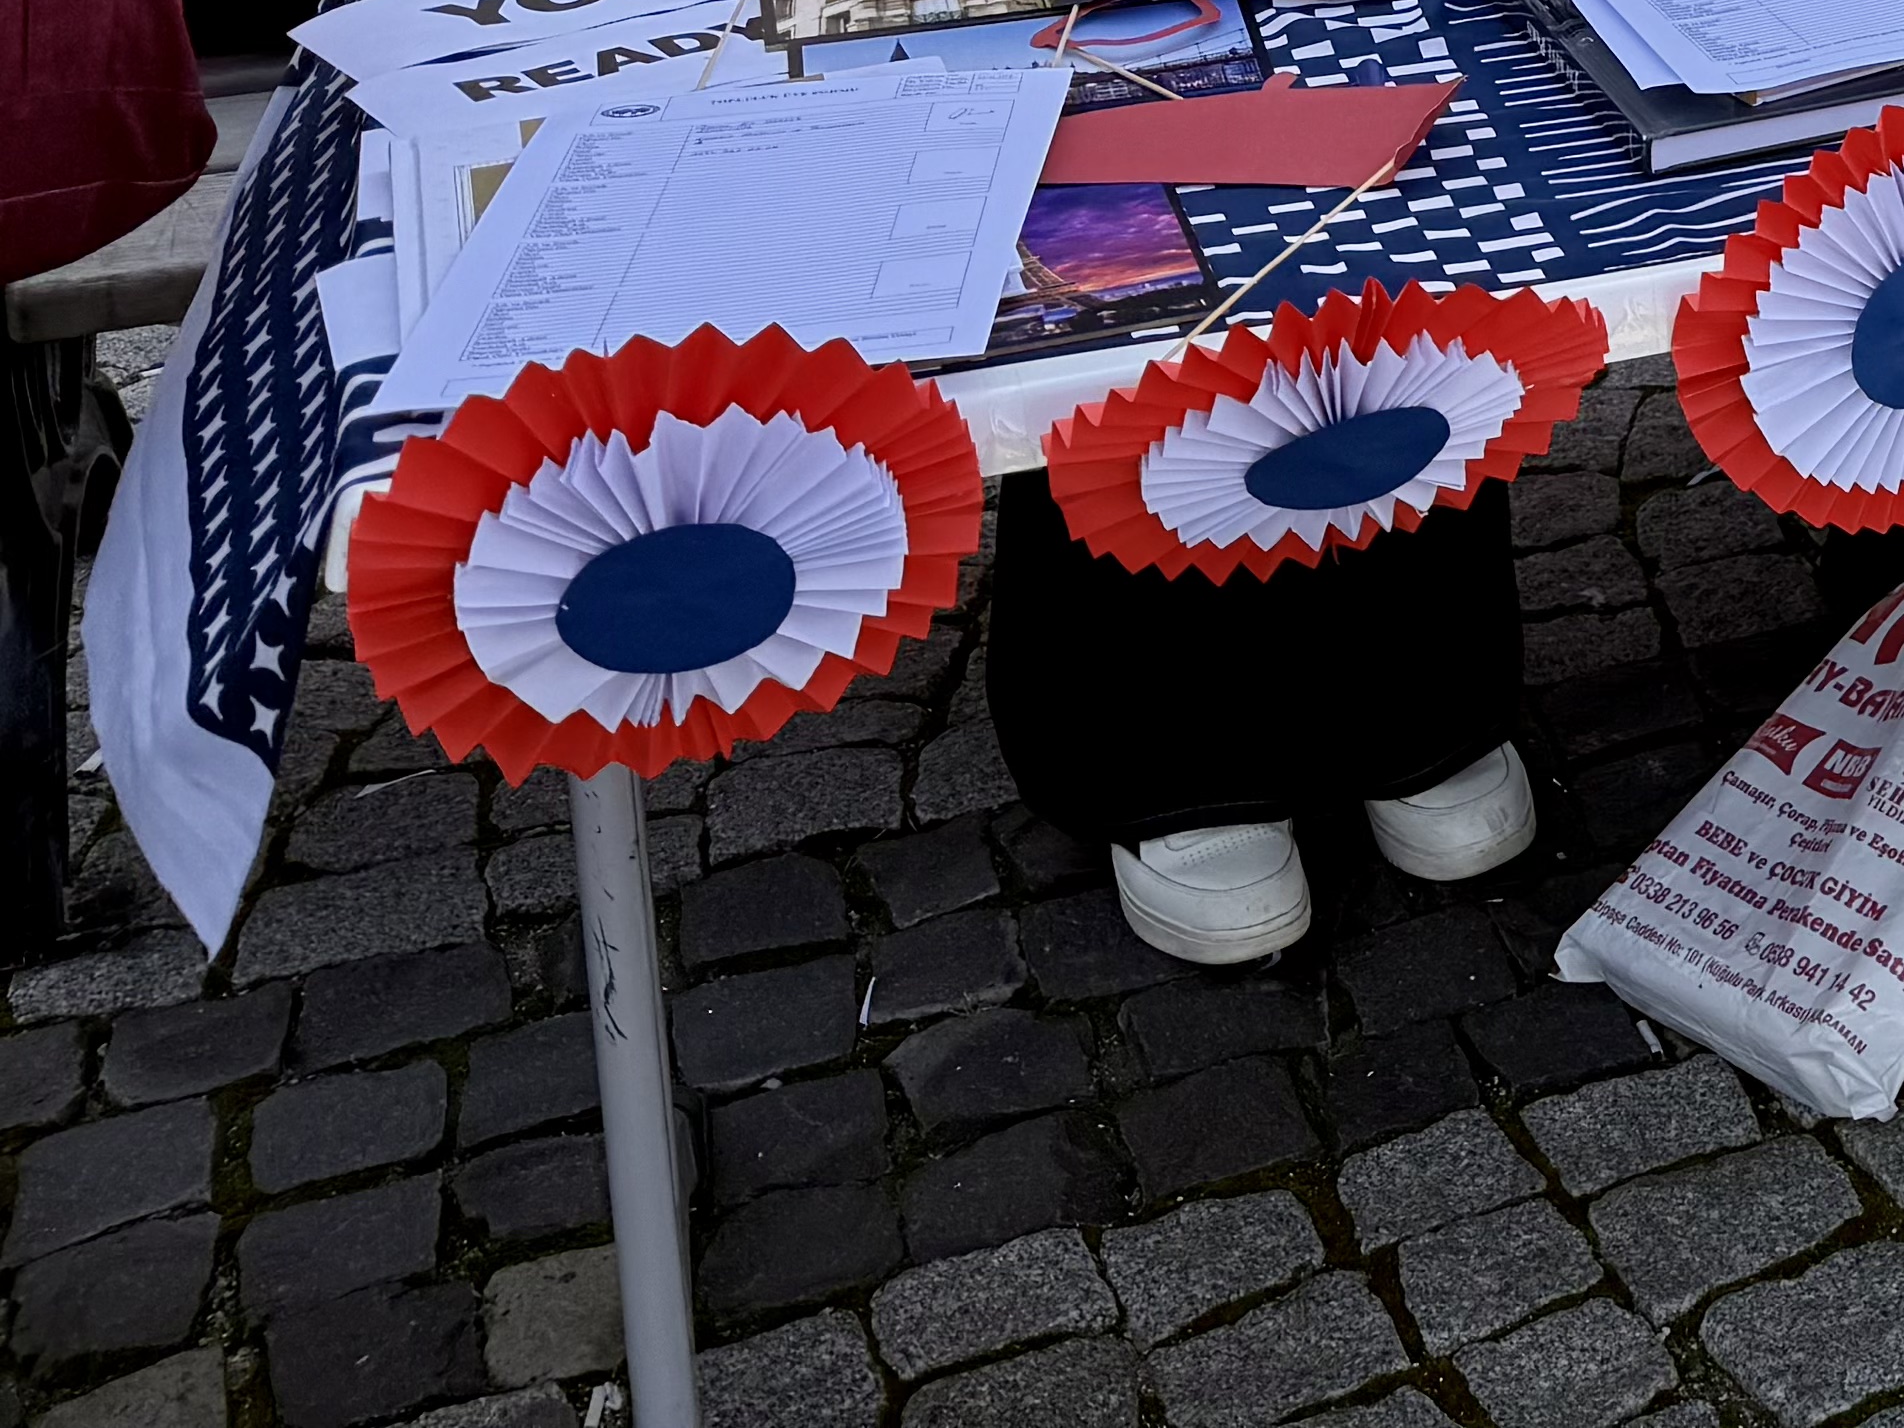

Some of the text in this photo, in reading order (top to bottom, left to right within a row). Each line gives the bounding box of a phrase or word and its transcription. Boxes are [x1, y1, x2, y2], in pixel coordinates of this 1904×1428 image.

[1722, 770, 1776, 810] Çamaşır,
[1778, 801, 1818, 832] Çorap,
[1850, 825, 1867, 841] ve
[1643, 839, 1690, 867] ptan
[1689, 855, 1769, 911] Fiyatına
[1767, 898, 1863, 954] Perakende
[1695, 820, 1748, 857] BEBE
[1747, 846, 1768, 870] ve
[1819, 878, 1889, 922] GİYİM
[1625, 915, 1668, 947] Caddesi
[1683, 947, 1704, 967] 101
[1630, 873, 1740, 940] 0338 213 96 56
[1793, 956, 1830, 987] 941
[1828, 971, 1852, 993] 14
[1849, 983, 1876, 1012] 42
